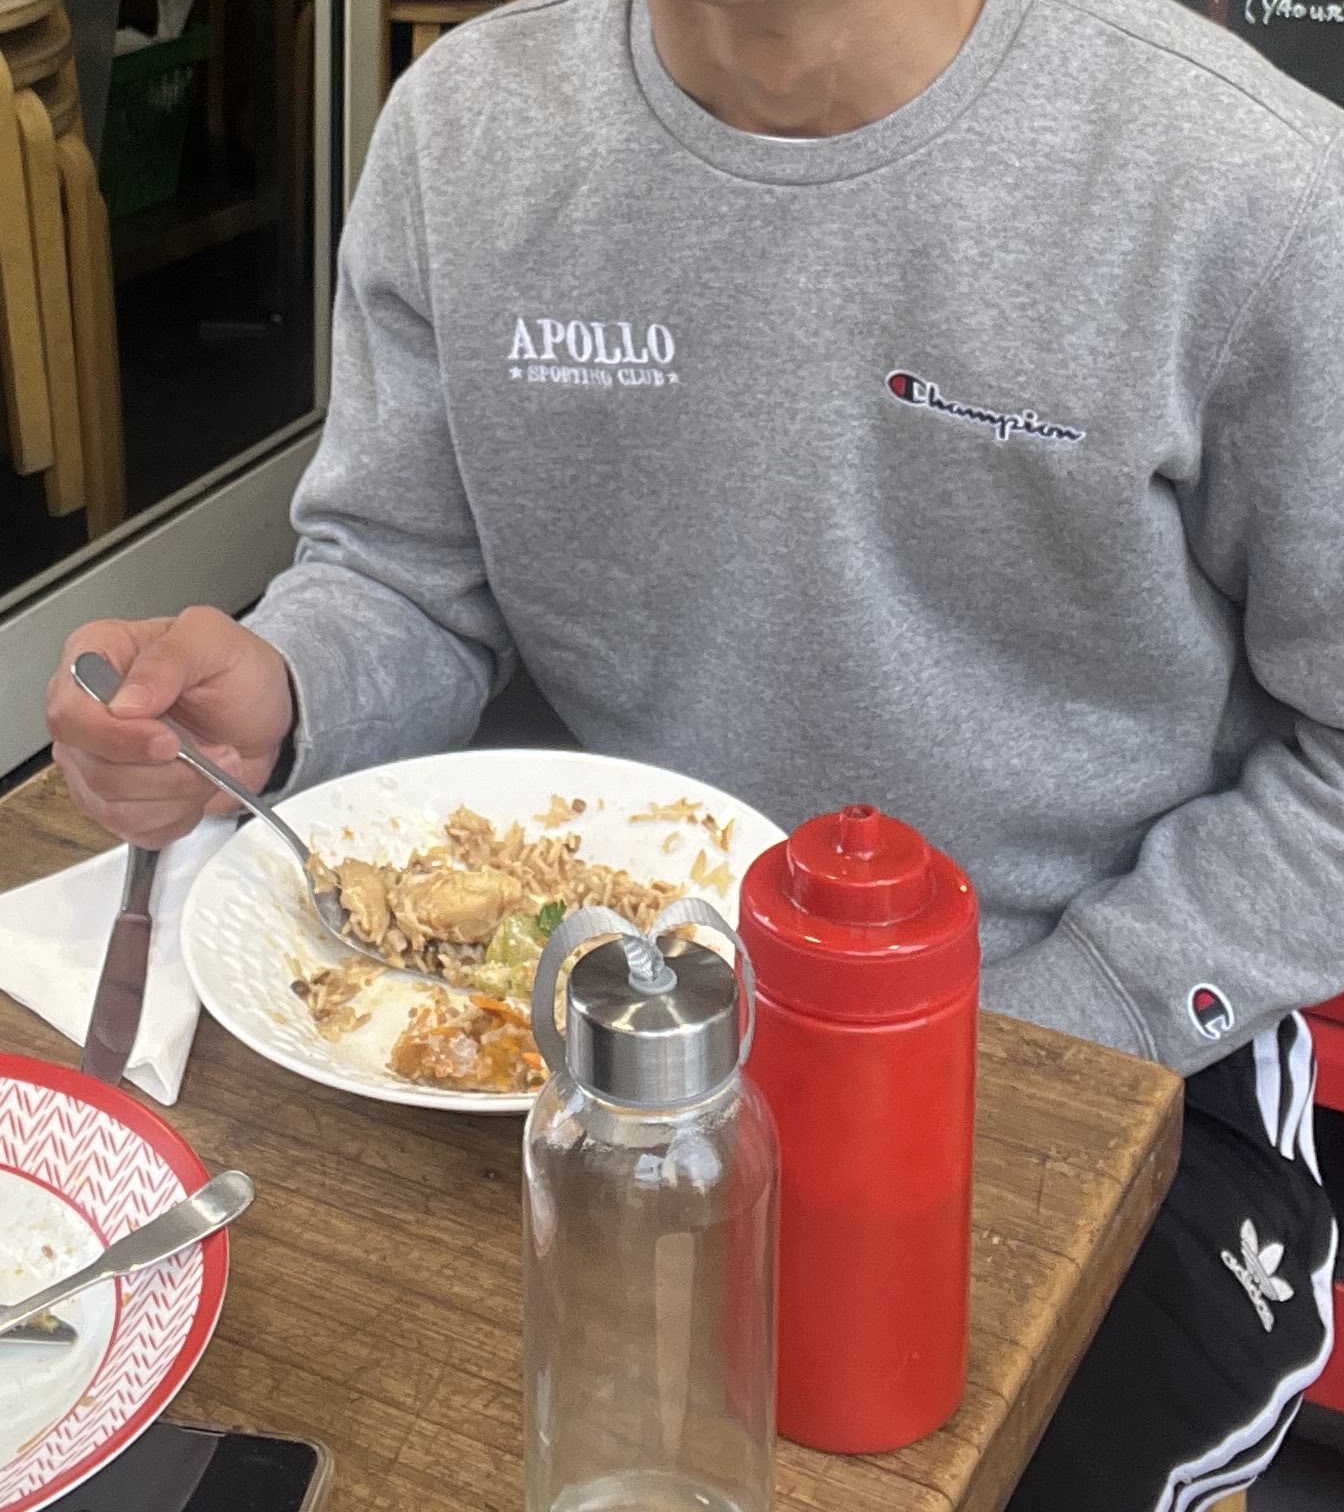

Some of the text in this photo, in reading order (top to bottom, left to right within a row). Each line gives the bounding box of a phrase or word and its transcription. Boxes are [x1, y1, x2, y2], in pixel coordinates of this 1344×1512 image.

[508, 317, 676, 365] APOLLO
[527, 364, 665, 388] SPORTING CLUB
[885, 369, 1087, 444] Champion
